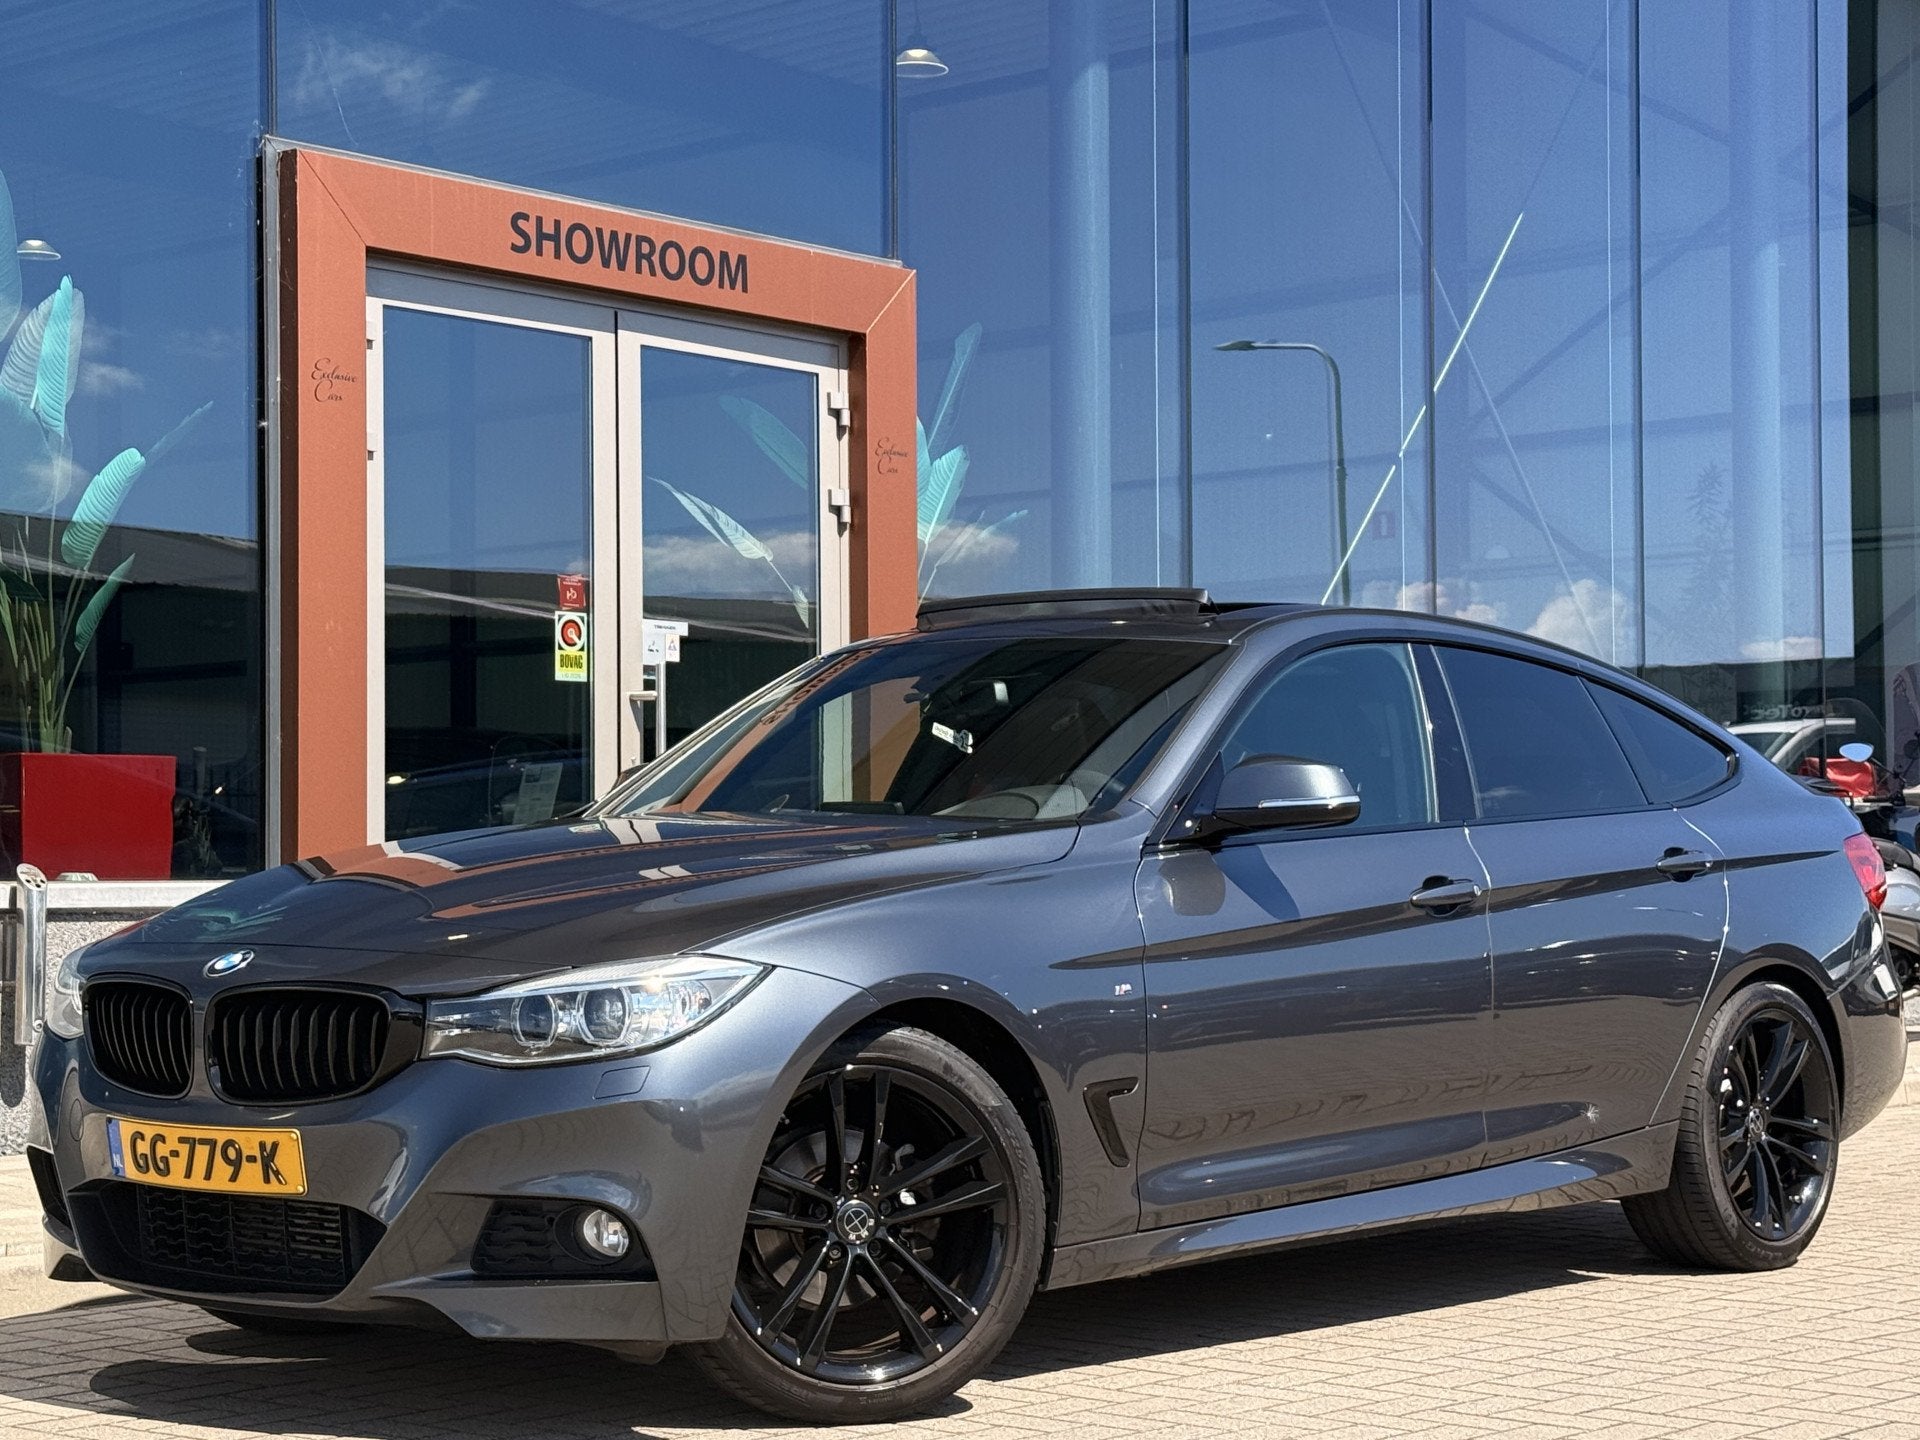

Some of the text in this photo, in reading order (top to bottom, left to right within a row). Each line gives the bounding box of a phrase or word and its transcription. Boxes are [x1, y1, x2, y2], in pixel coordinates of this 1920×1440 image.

[510, 211, 748, 293] SHOWROOM
[560, 654, 583, 669] BOVAG
[112, 1153, 123, 1168] NL
[130, 1131, 287, 1185] GG-779-K
